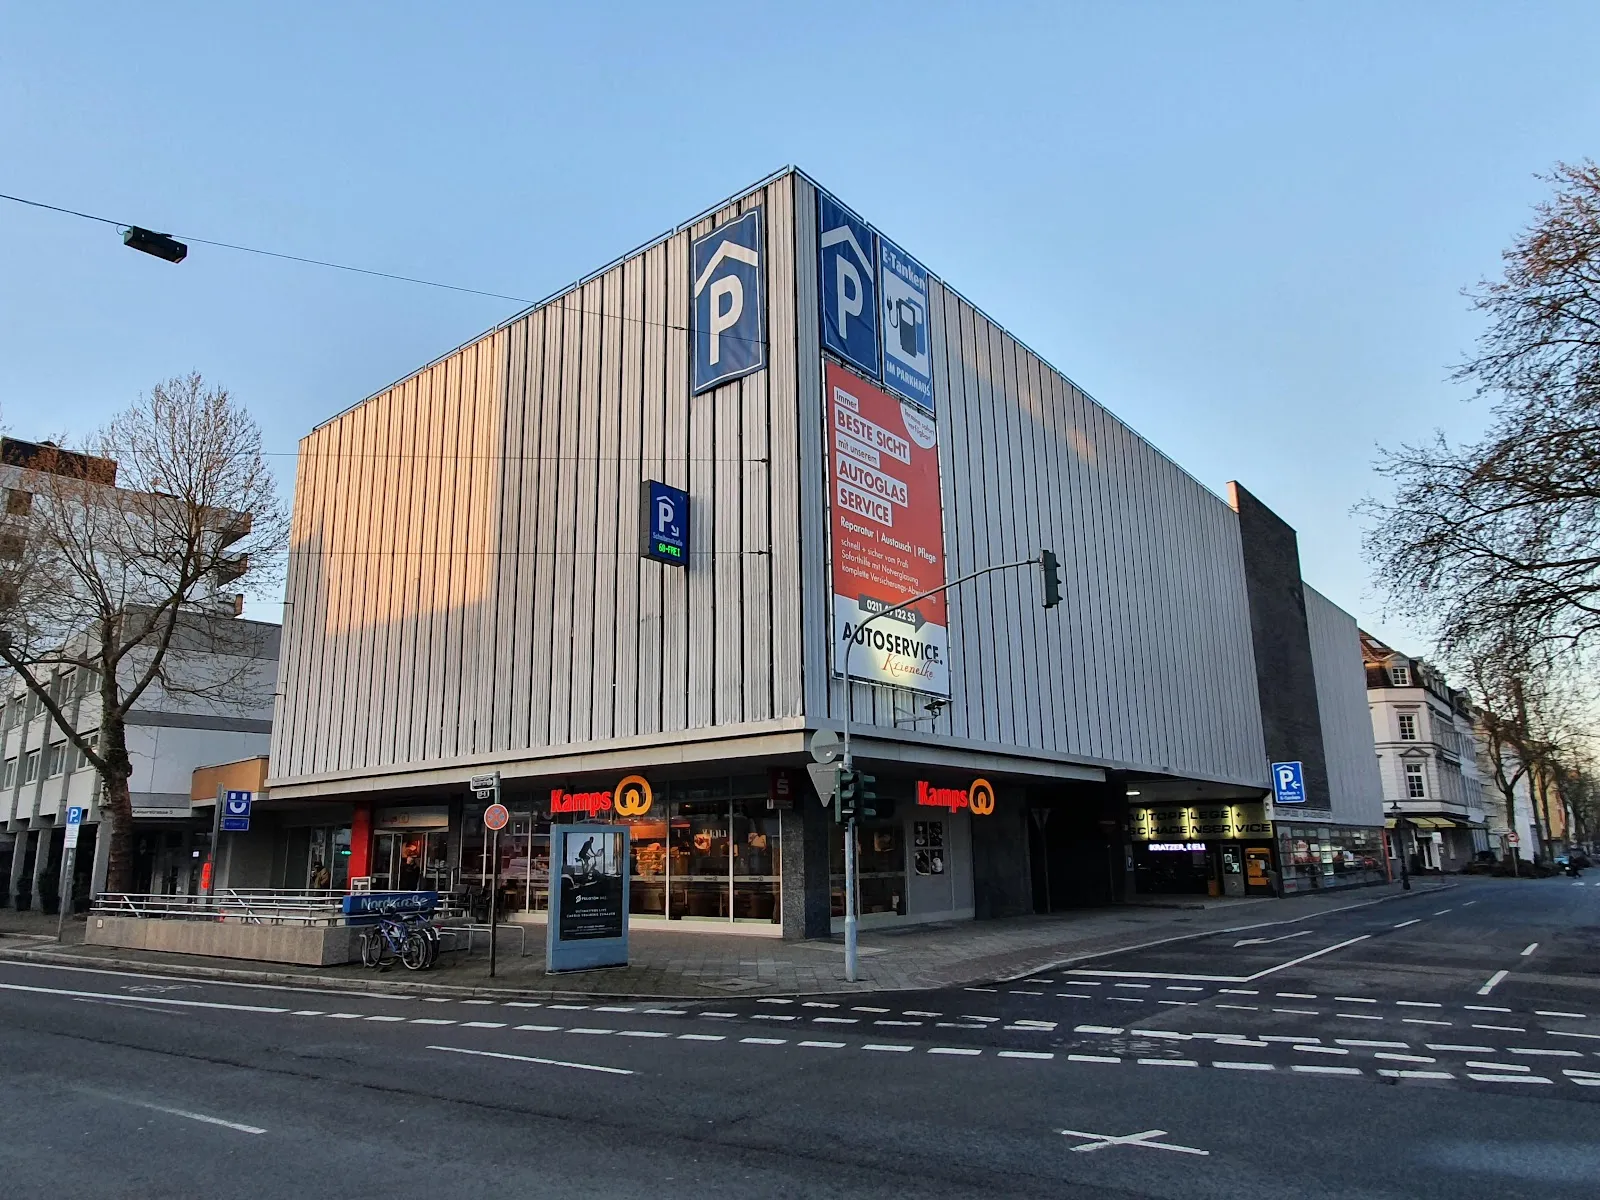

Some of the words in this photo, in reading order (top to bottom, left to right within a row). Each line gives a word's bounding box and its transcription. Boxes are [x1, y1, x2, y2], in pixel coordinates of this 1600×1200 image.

[882, 247, 925, 292] E-Tanken
[836, 254, 863, 340] P
[710, 274, 743, 366] P
[886, 361, 895, 377] IM
[896, 367, 931, 397] PARKHAUS
[836, 391, 857, 408] Immer
[837, 409, 873, 442] BESTE
[876, 430, 907, 459] SICHT
[838, 438, 849, 451] mit
[850, 445, 877, 463] unserem
[839, 460, 906, 503] AUTOGLAS
[658, 501, 674, 532] P
[840, 488, 889, 523] SERVICE
[840, 516, 874, 538] Reparatur
[881, 532, 912, 553] Austausch
[918, 547, 936, 564] Pflege
[841, 537, 861, 551] schnell
[867, 547, 883, 559] sicher
[884, 555, 896, 564] vom
[897, 557, 909, 568] Profi
[841, 549, 870, 568] Soforthilfe
[871, 561, 880, 570] mit
[881, 564, 919, 587] Notverglasung
[841, 561, 869, 580] komplette
[866, 599, 882, 612] 0211
[895, 608, 907, 620] 122
[907, 611, 916, 623] 53
[1279, 769, 1294, 790] P
[551, 789, 612, 817] Kamps
[917, 780, 968, 813] Kamps
[70, 809, 78, 822] P
[1130, 823, 1271, 836] SCHADENSERVICE
